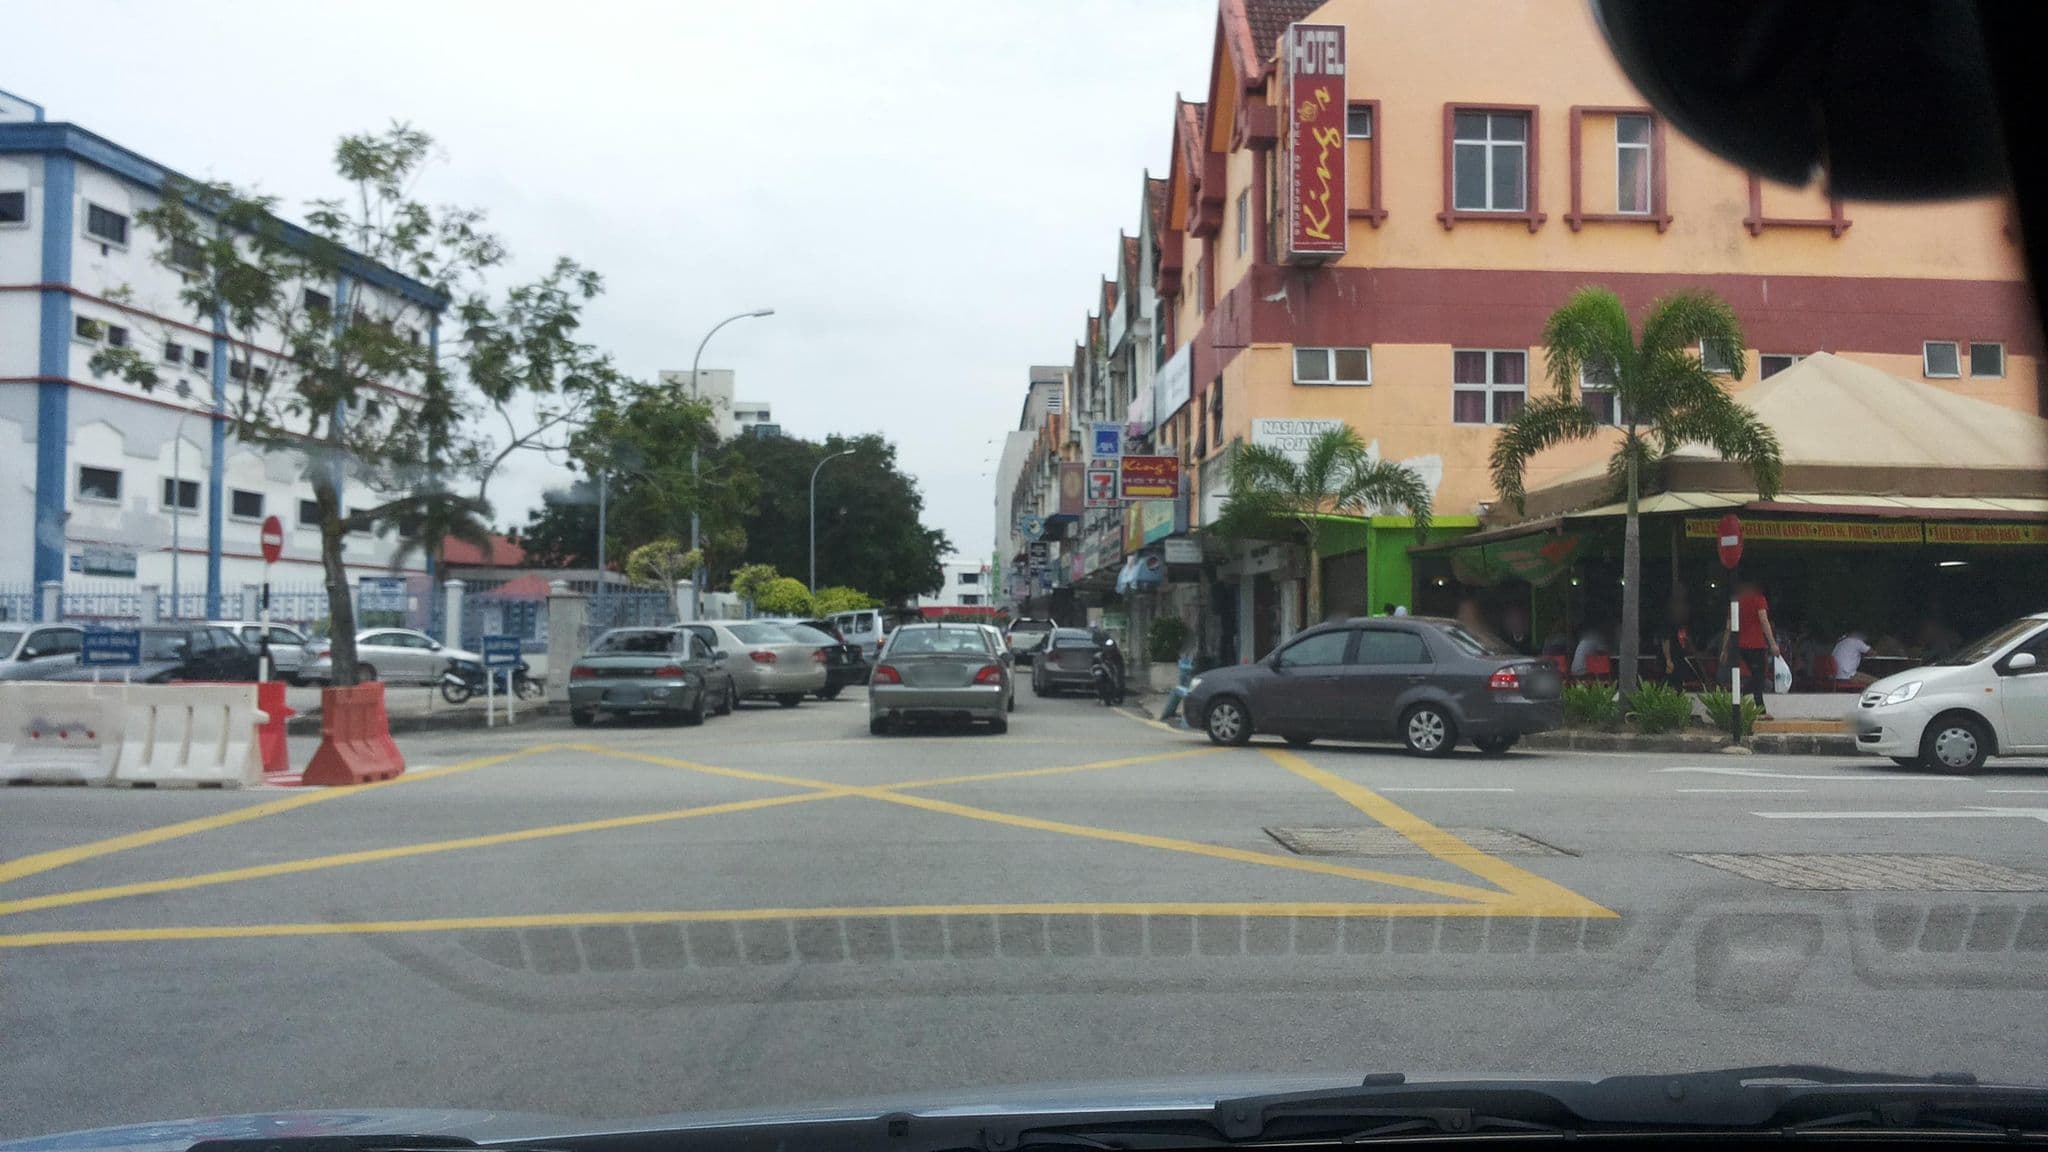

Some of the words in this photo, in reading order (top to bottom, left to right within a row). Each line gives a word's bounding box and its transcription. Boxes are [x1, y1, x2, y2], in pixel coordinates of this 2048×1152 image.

[1294, 31, 1344, 75] HOTEL
[1263, 421, 1293, 435] NASI
[1295, 421, 1330, 435] AYAM
[1123, 459, 1178, 475] King's
